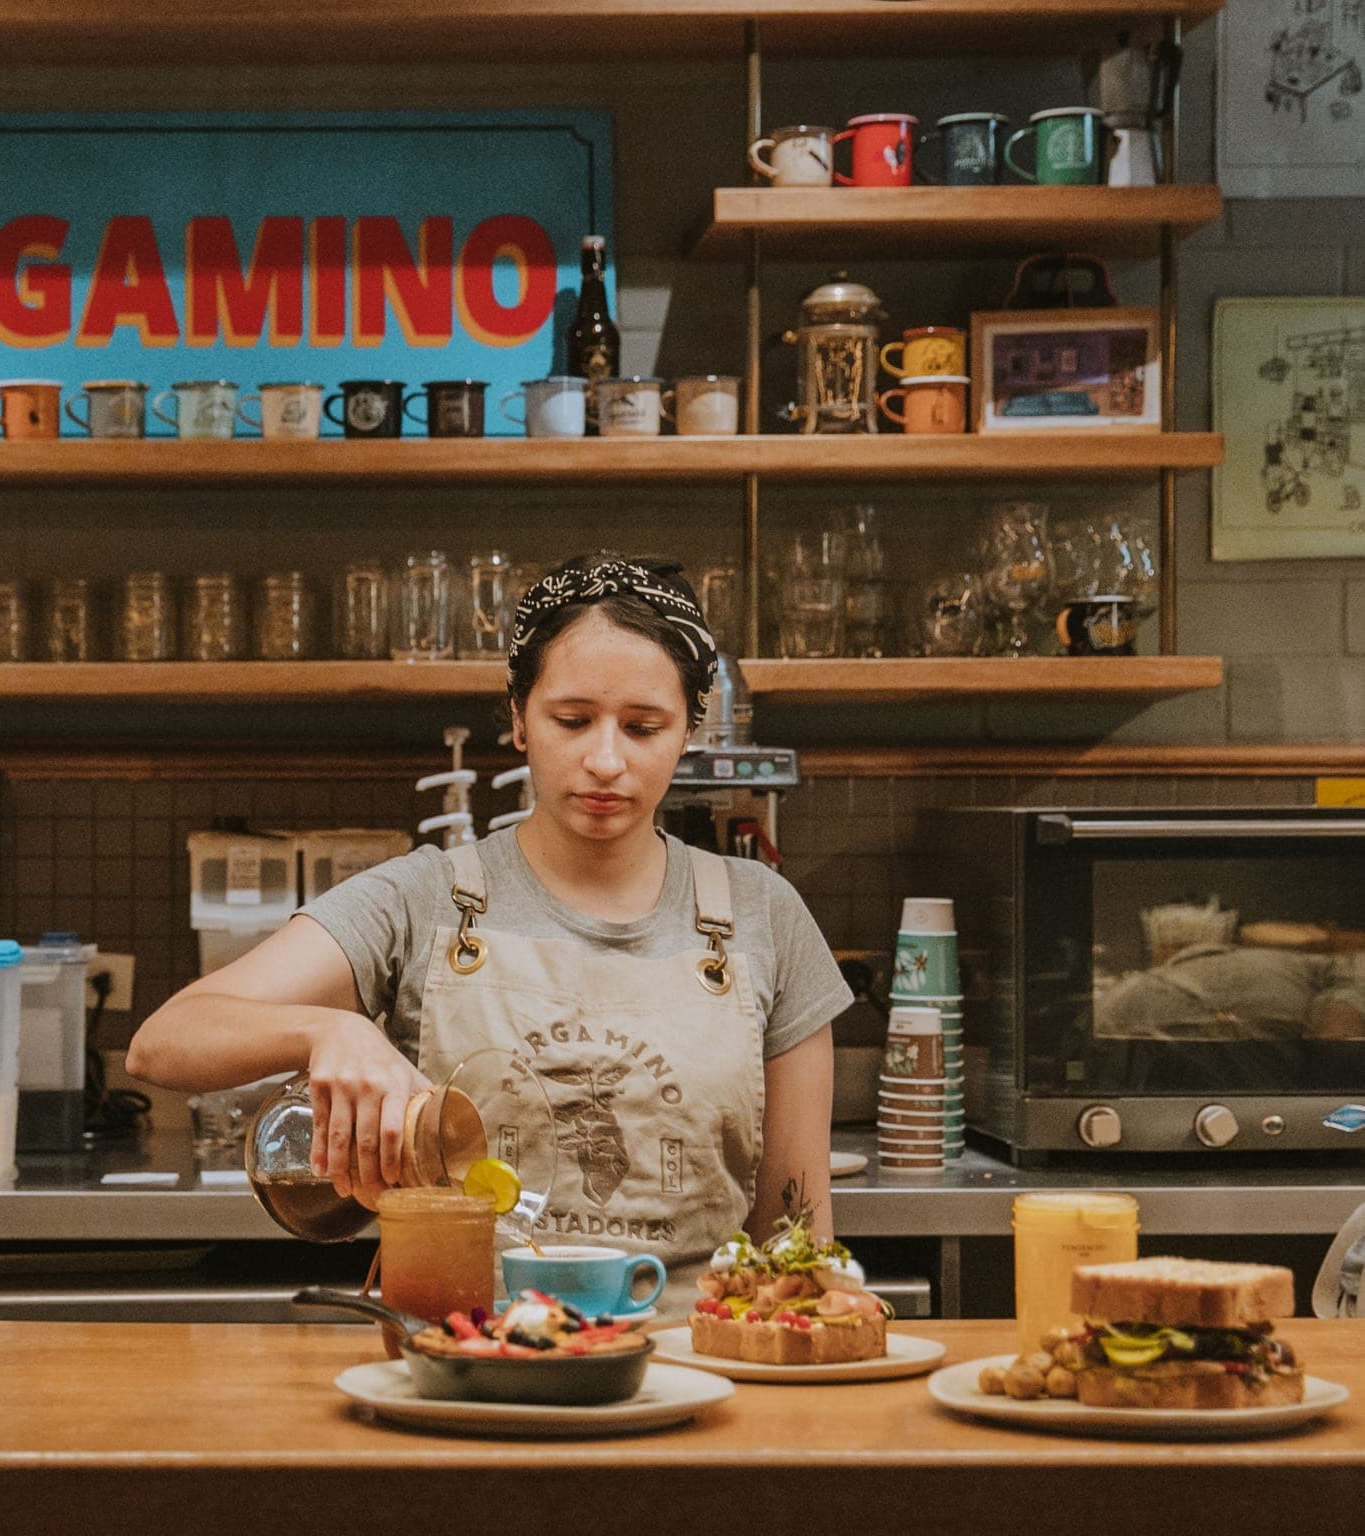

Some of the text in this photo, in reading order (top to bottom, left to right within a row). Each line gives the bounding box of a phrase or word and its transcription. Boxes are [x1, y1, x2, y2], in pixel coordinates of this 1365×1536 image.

[501, 1020, 683, 1105] PERGAMINO
[666, 1144, 678, 1188] COL
[519, 1209, 676, 1242] STADORES
